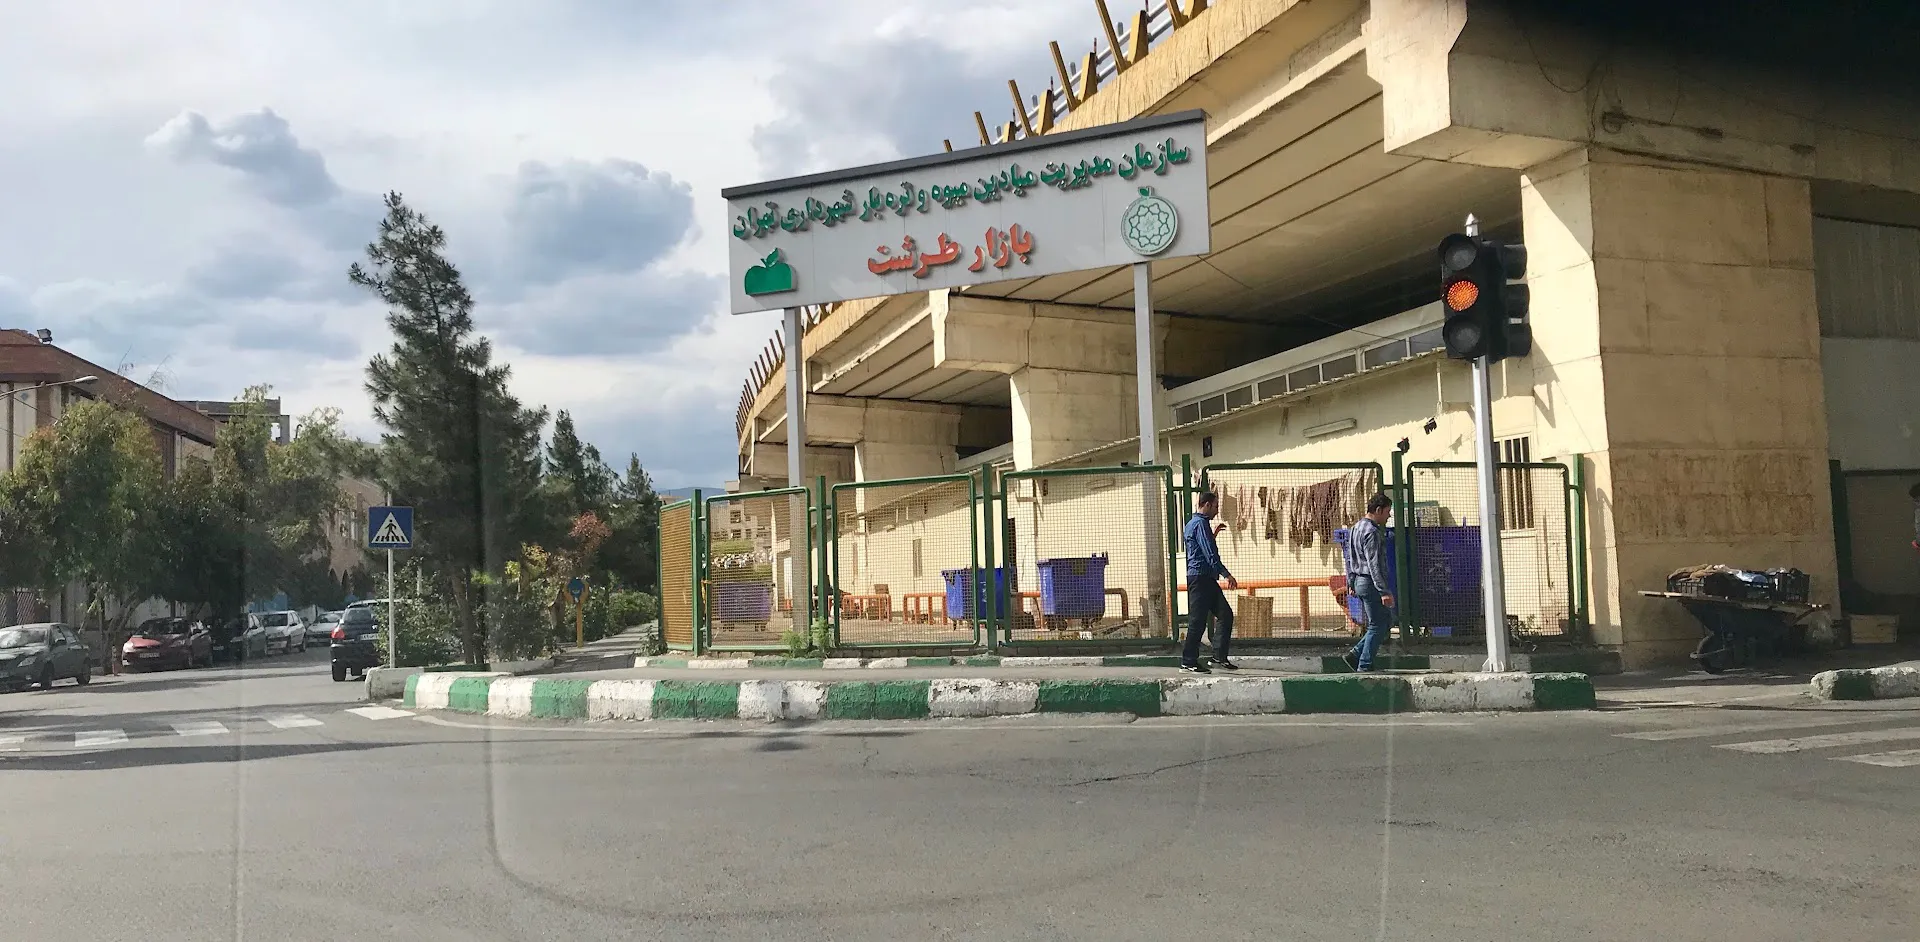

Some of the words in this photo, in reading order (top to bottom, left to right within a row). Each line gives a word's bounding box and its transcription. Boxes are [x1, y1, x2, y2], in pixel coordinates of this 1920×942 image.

[1040, 155, 1112, 191] مدیریت
[1118, 137, 1189, 179] سازمان
[917, 189, 930, 213] و
[931, 181, 971, 209] میوه
[973, 163, 1036, 203] میادین
[733, 202, 778, 239] تهران
[780, 189, 854, 232] شهرداری
[867, 232, 962, 279] طرشت
[968, 223, 1033, 272] بازار
